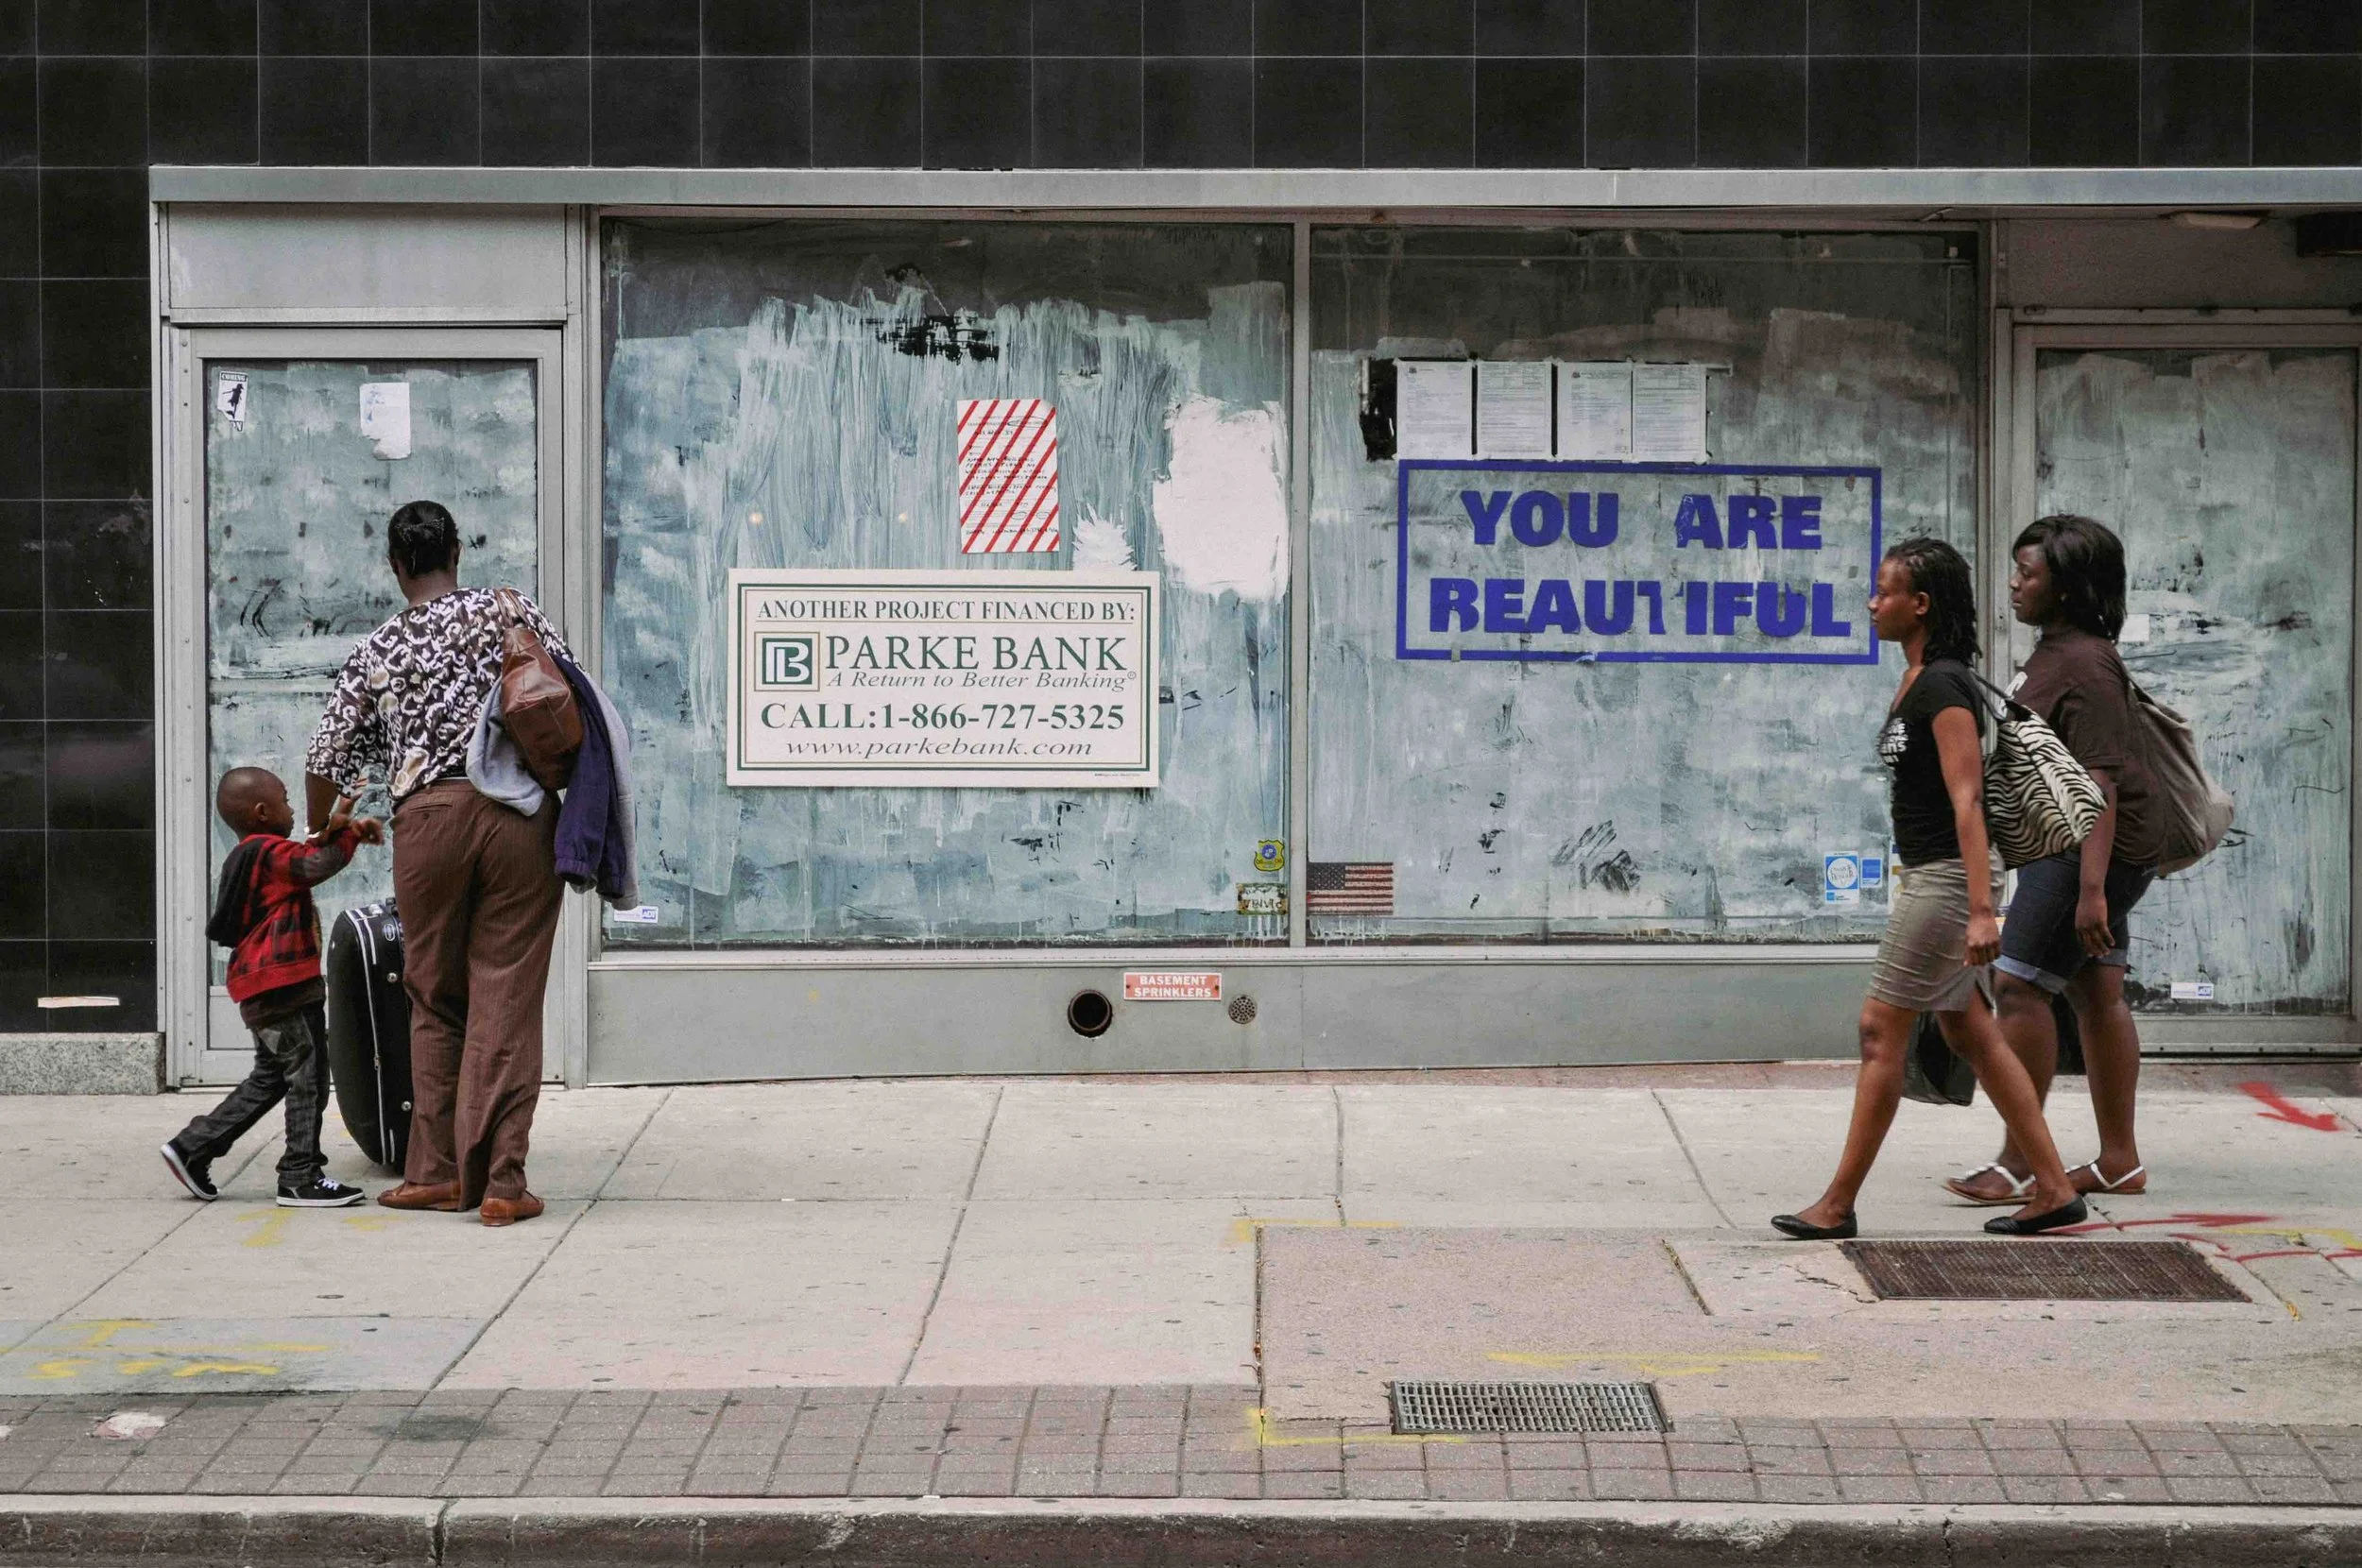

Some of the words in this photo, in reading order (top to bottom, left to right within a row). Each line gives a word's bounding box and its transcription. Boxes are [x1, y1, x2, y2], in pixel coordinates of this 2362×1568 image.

[1461, 489, 1618, 548] YOU
[1674, 493, 1822, 550] ARE
[758, 600, 868, 619] ANOTHER
[875, 601, 975, 620] PROJECT
[983, 602, 1094, 621] FINANCED
[1102, 603, 1135, 621] BY:
[1429, 577, 1851, 637] BEAUTIFUL
[826, 635, 979, 670] PARKE
[992, 637, 1127, 671] BANK
[827, 672, 843, 687] A
[851, 672, 926, 688] Return
[933, 673, 953, 688] to
[963, 673, 1029, 688] Better
[787, 737, 1092, 759] www.parkebank.com
[1139, 976, 1207, 985] BASEMENT
[1134, 987, 1211, 997] SPRINKLERS
